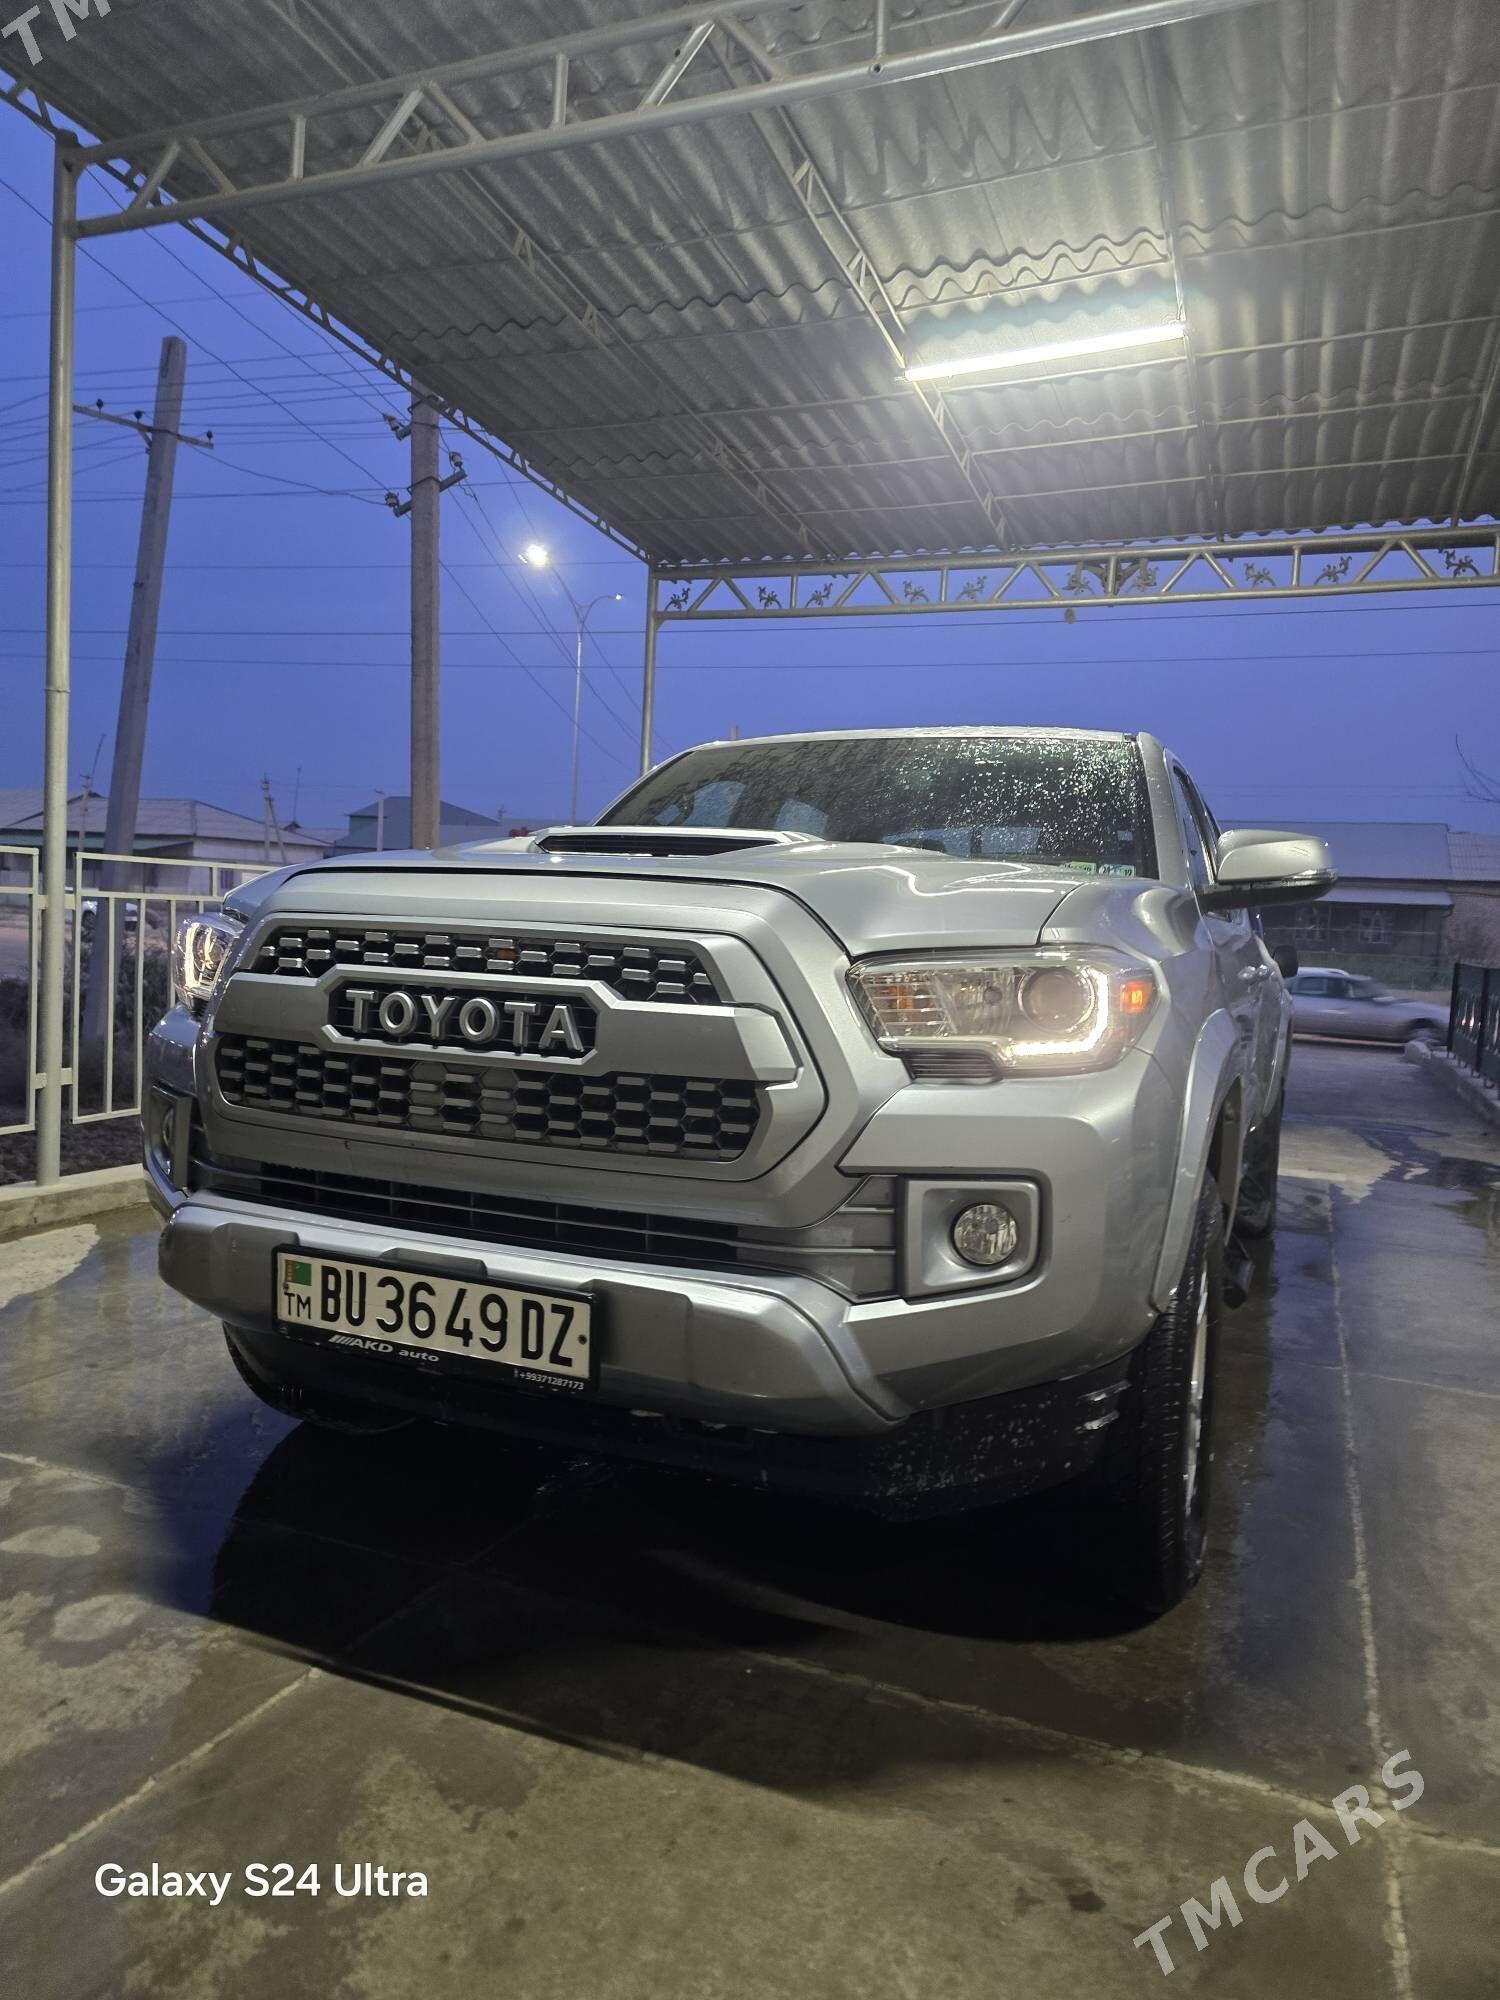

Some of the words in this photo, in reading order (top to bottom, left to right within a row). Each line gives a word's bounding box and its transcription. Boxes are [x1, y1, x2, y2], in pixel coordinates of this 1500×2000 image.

[345, 989, 585, 1052] TOYOTA
[284, 1291, 312, 1320] TM
[320, 1264, 367, 1328] BU
[376, 1276, 508, 1353] 3649
[521, 1298, 575, 1368] DZ
[398, 1349, 440, 1363] auto
